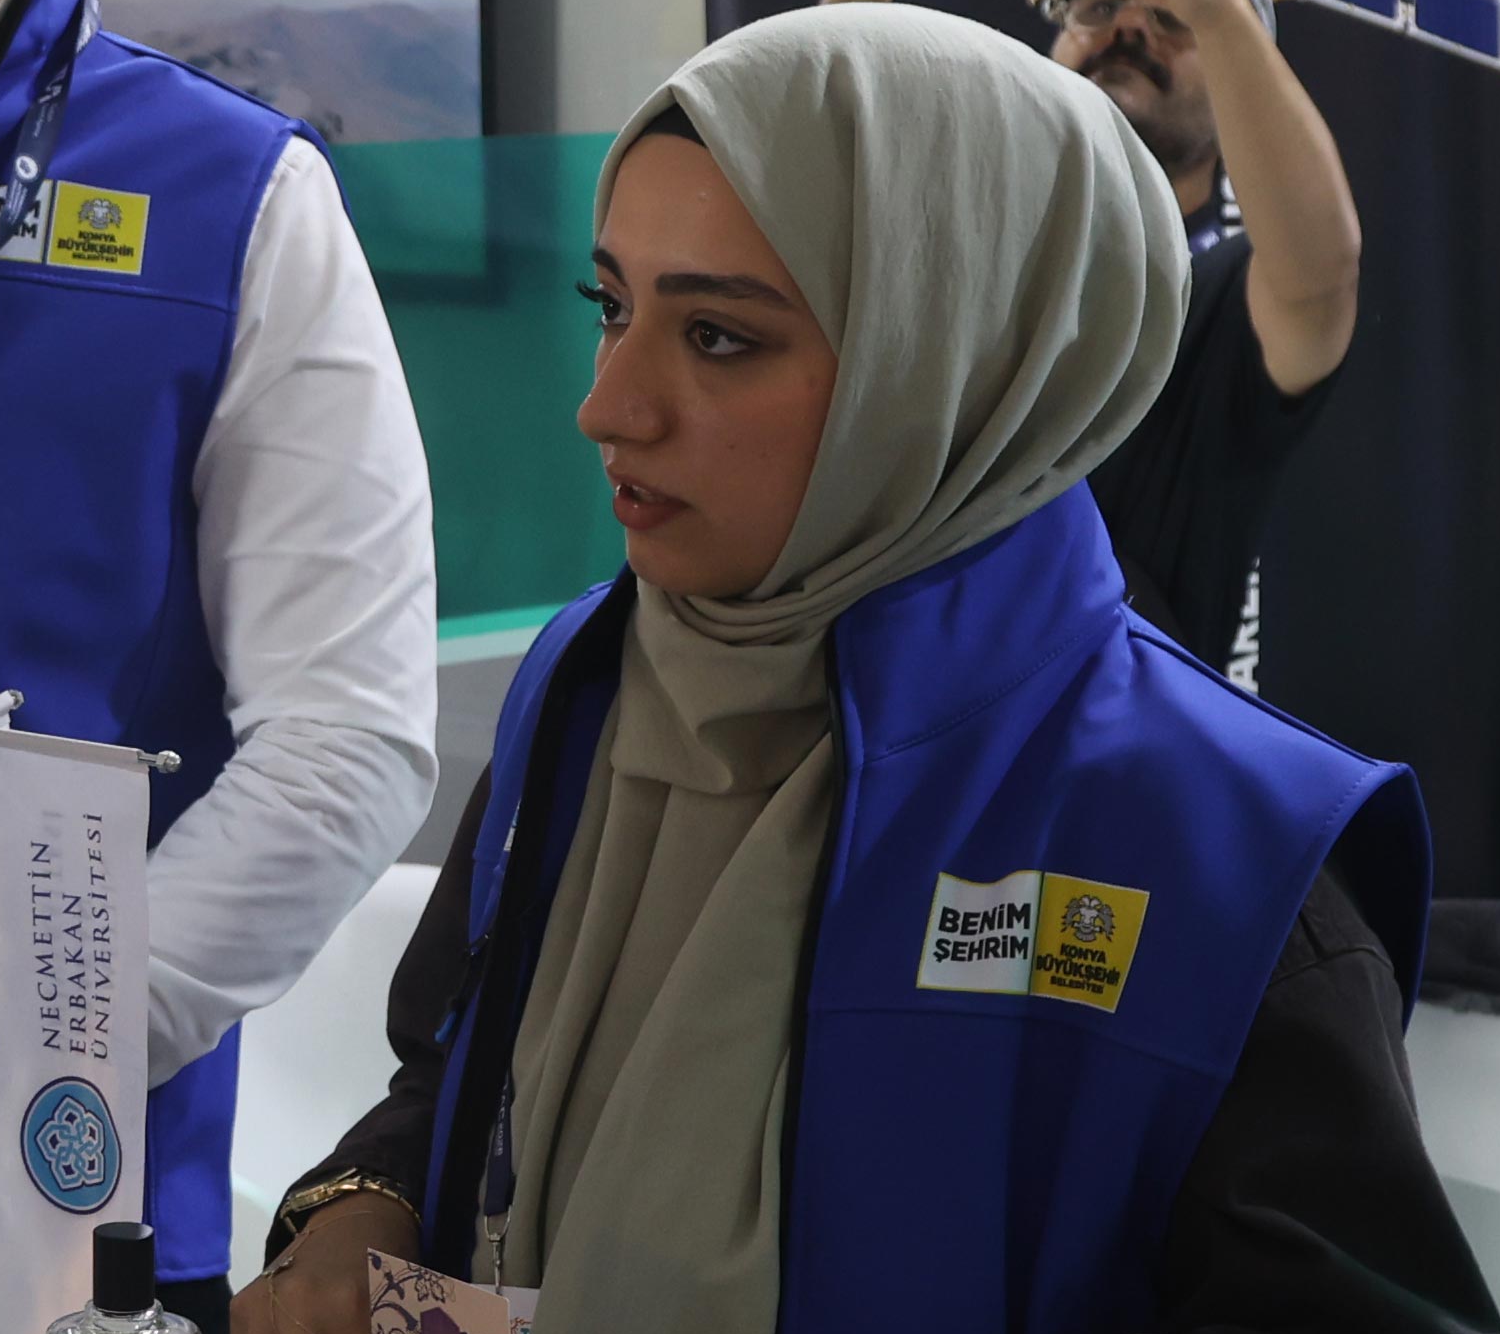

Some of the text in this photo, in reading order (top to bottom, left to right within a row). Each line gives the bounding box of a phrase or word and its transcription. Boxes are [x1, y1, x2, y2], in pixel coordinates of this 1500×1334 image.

[27, 841, 61, 1050] NECMETTİN
[62, 893, 87, 1054] ERBAKAN
[83, 813, 112, 1060] ÜNİVERSİTESİ
[1060, 943, 1107, 965] KONYA
